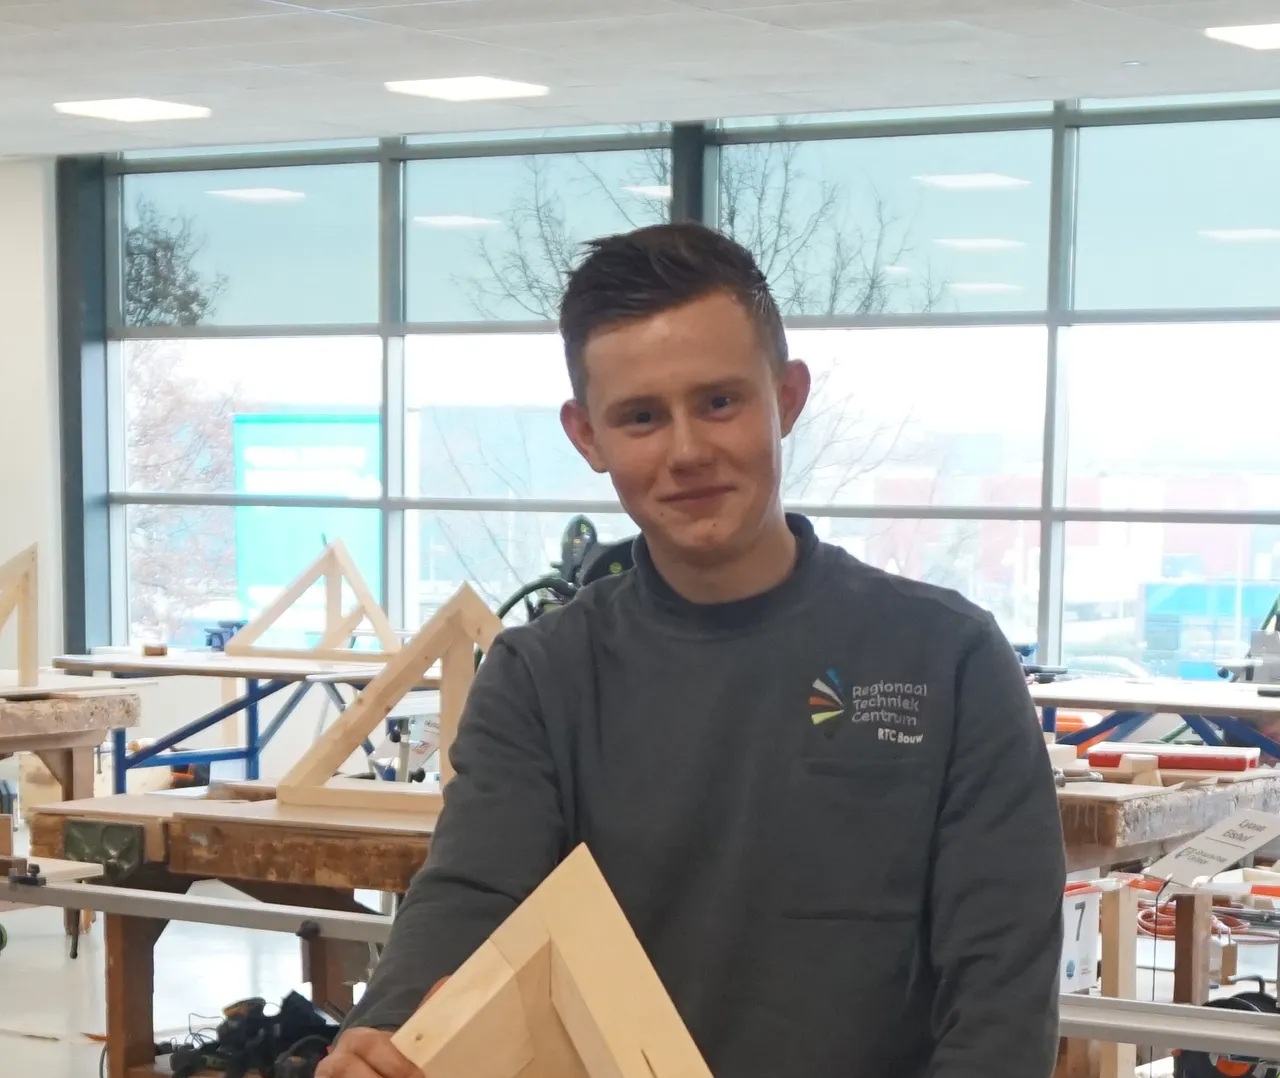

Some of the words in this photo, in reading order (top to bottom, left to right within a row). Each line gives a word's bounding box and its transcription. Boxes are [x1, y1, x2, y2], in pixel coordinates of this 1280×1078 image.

[852, 680, 927, 698] Regionaal
[852, 694, 919, 712] Techniek
[851, 709, 917, 726] Centrum
[877, 727, 897, 741] RTC
[897, 731, 924, 744] Bouw
[1074, 901, 1087, 942] 7
